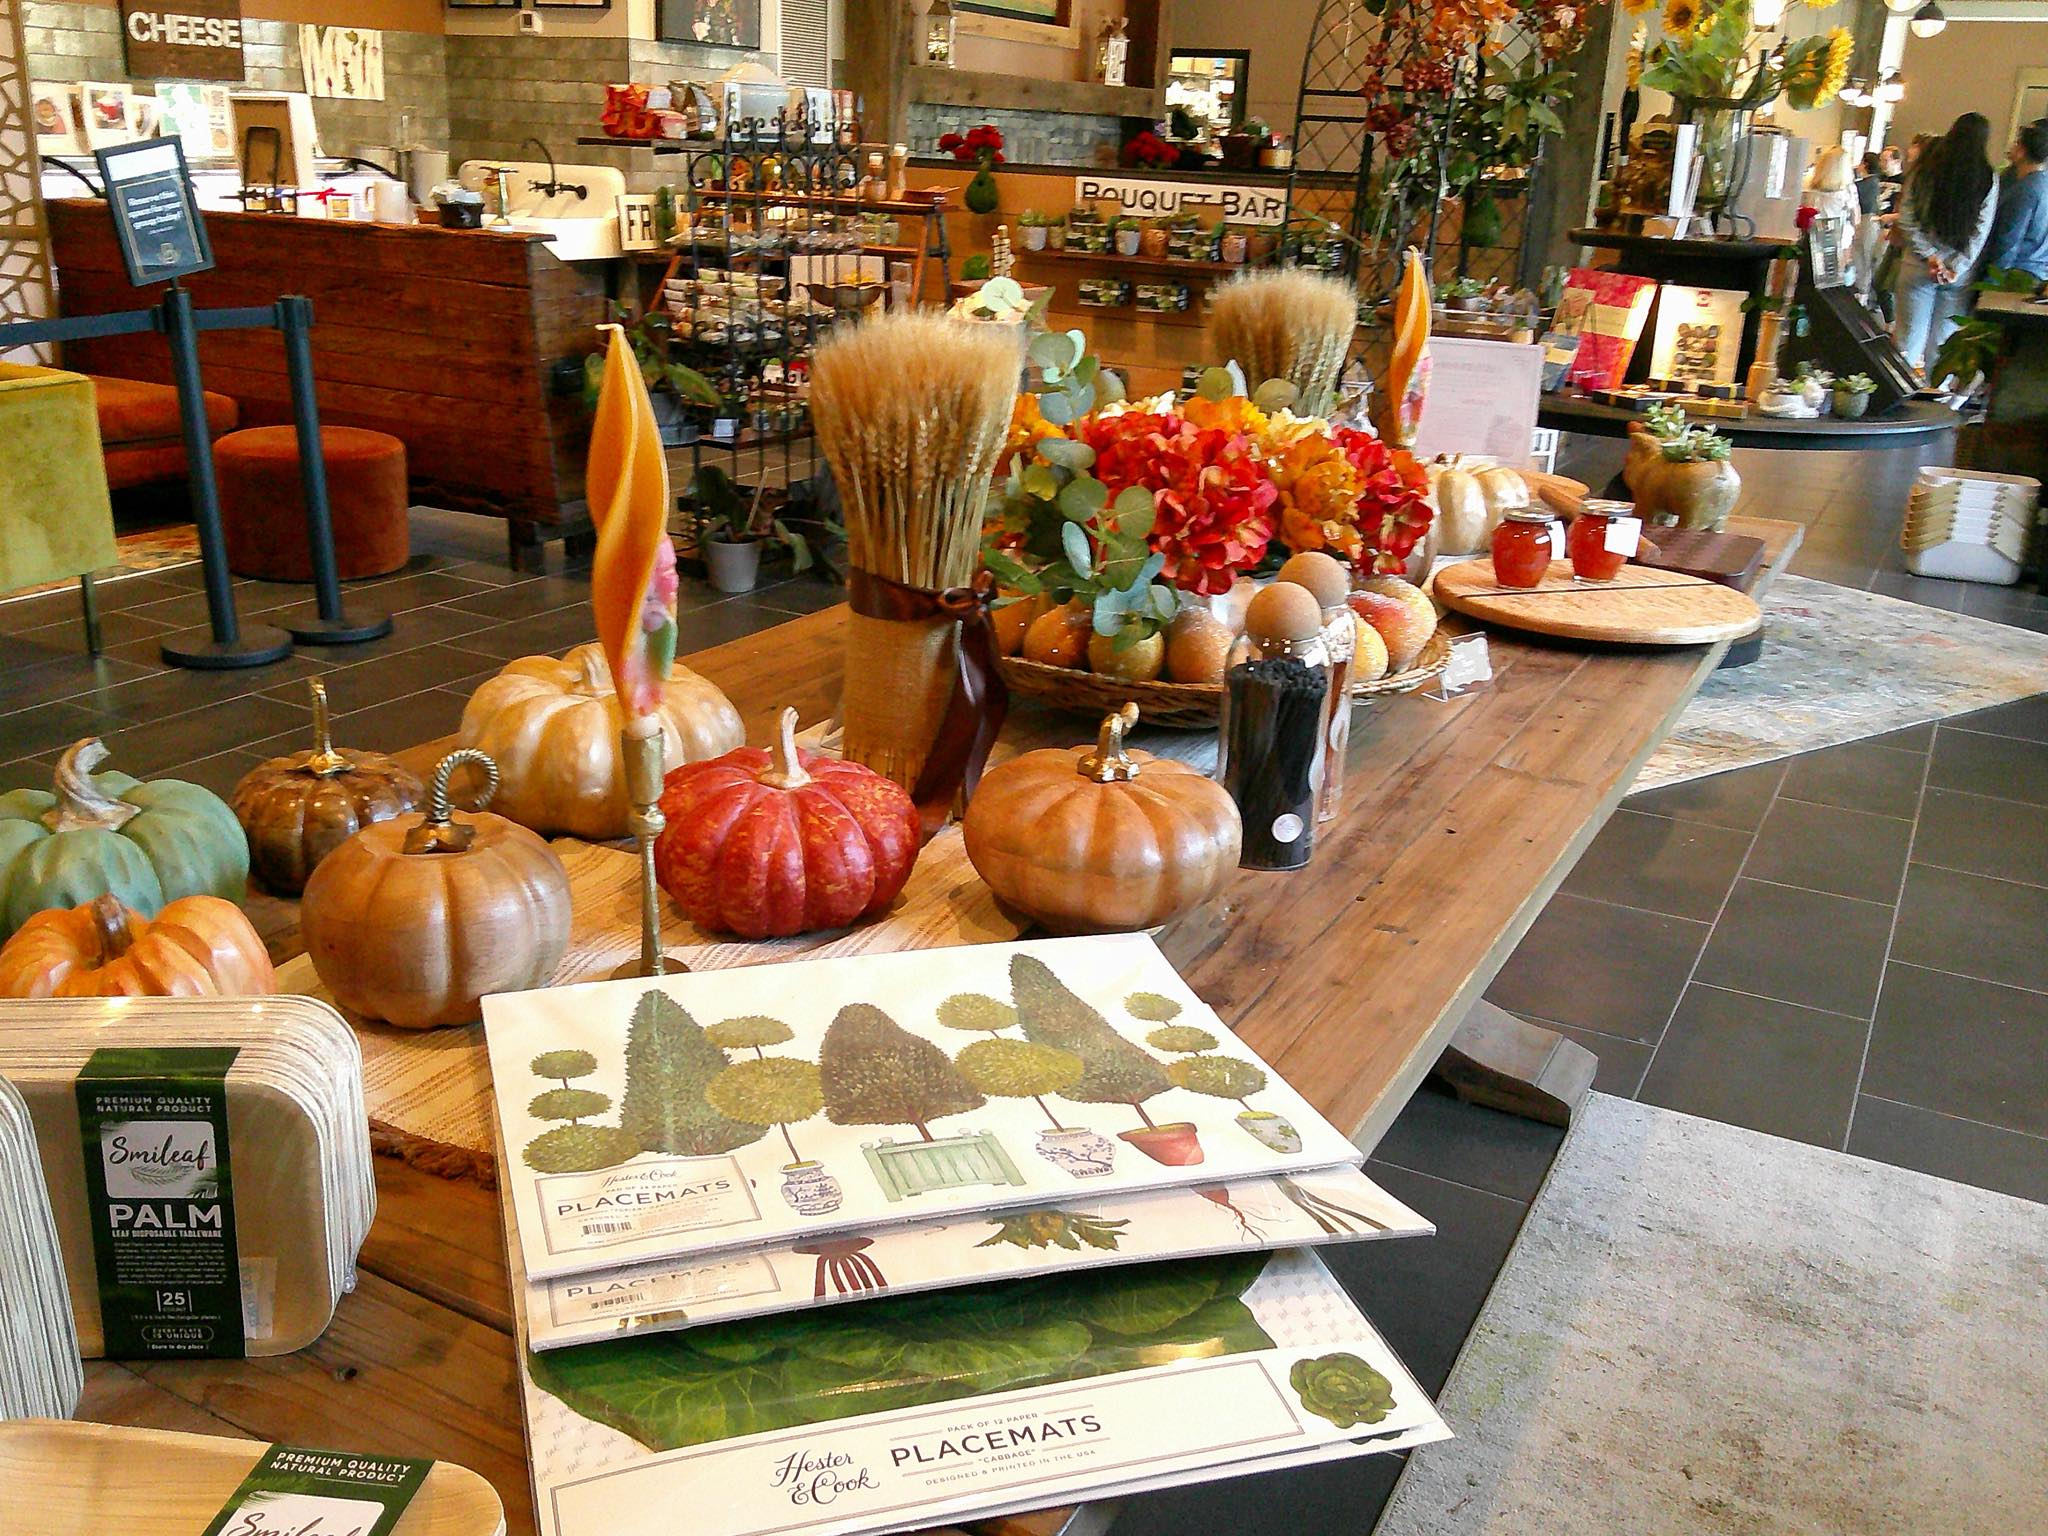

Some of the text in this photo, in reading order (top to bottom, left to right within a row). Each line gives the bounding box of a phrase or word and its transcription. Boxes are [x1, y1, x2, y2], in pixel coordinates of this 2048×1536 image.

[128, 11, 241, 49] CHEESE
[1221, 191, 1281, 219] BAR
[95, 1096, 211, 1104] PREMIUM QUALITY
[96, 1105, 212, 1113] NATURAL PRODUCT
[109, 1134, 210, 1171] Smileaf
[557, 1179, 731, 1216] PLACEMATS
[109, 1204, 222, 1228] PALM
[112, 1230, 222, 1238] LEAF DISPOSABLE TABLEWARE
[162, 1292, 186, 1306] 25
[947, 1424, 974, 1434] PACK
[977, 1420, 990, 1428] OF
[1006, 1412, 1039, 1424] PAPER
[890, 1415, 1102, 1467] PLACEMATS
[270, 1461, 407, 1483] NATURAL PRODUCT
[276, 1452, 412, 1474] PREMIUM QUALITY
[770, 1449, 855, 1487] Hester
[925, 1471, 978, 1486] DESIGNED
[992, 1460, 1036, 1474] PRINTED
[1054, 1454, 1073, 1462] THE
[1076, 1449, 1097, 1458] USA
